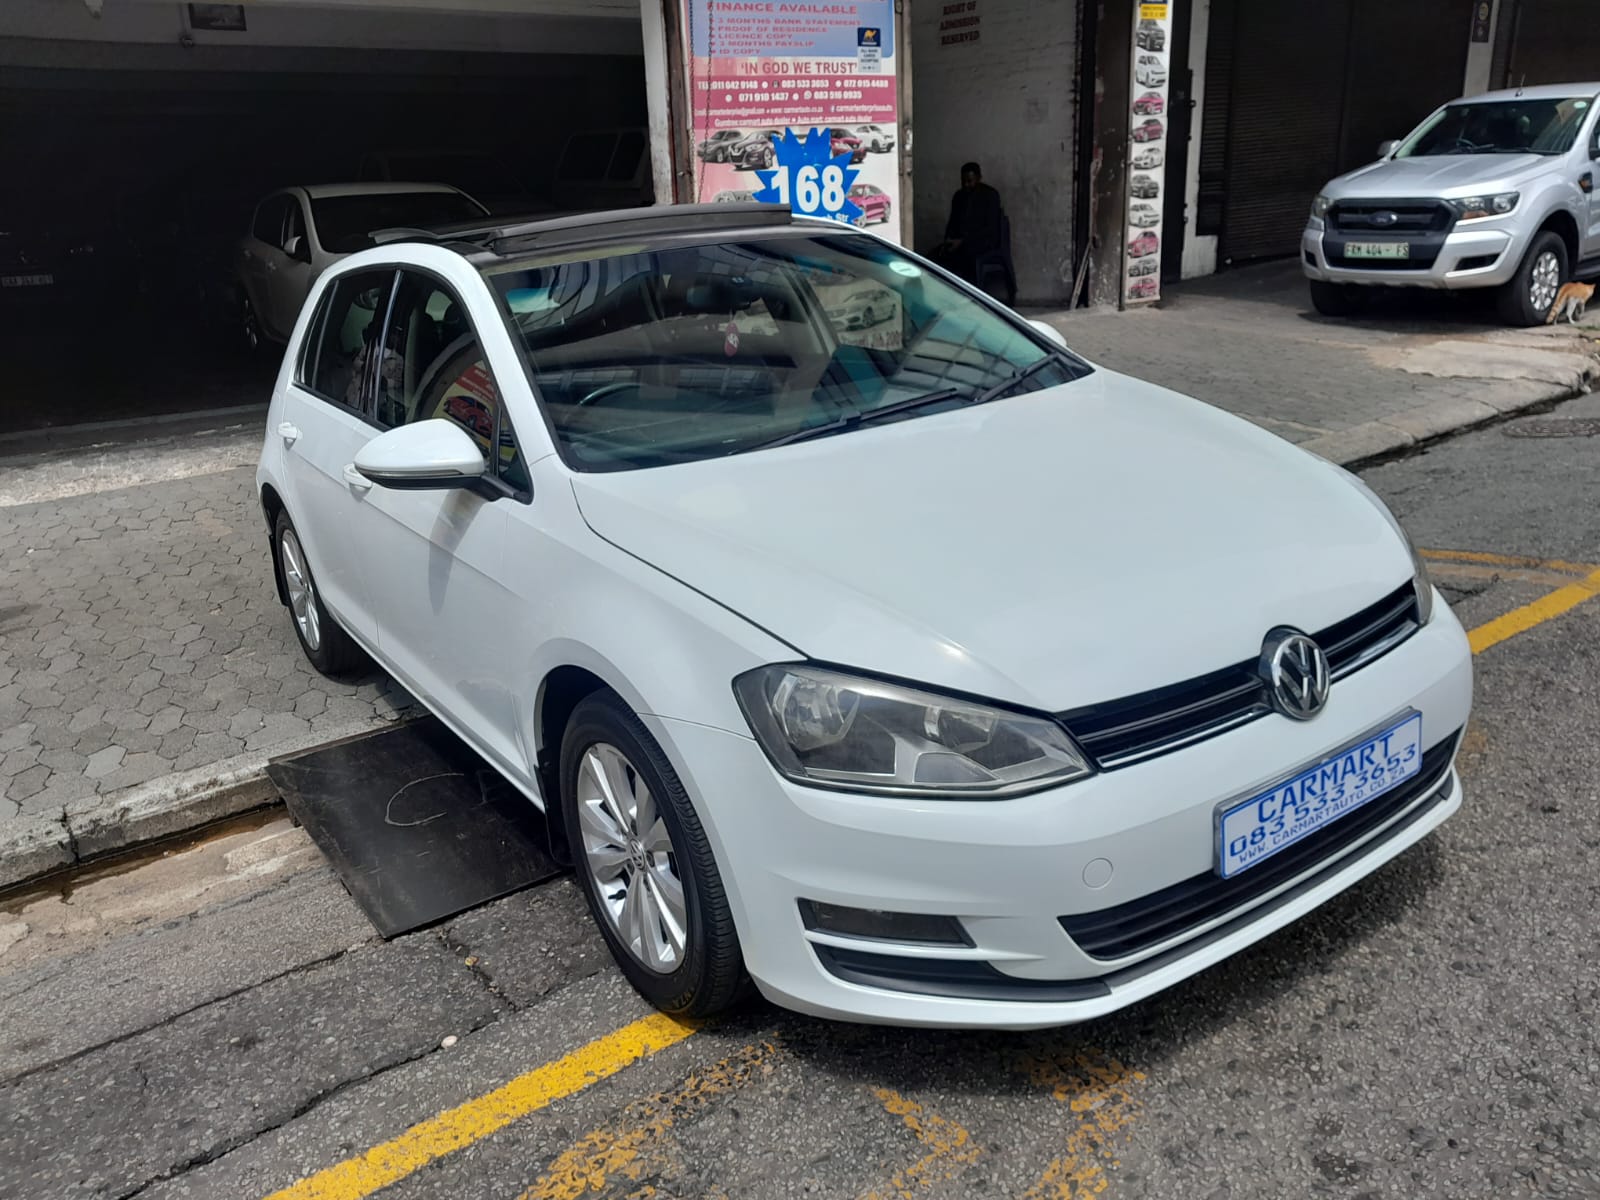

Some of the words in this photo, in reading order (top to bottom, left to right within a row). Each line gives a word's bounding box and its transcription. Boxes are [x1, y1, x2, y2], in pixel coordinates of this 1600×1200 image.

[706, 2, 777, 13] FINANCE
[779, 4, 858, 15] AVAILABLE
[941, 31, 980, 46] RESERVED
[762, 63, 789, 75] GOD
[791, 63, 812, 74] WE
[770, 164, 844, 213] 168
[1257, 733, 1394, 823] CARMART
[1230, 815, 1286, 857] 083
[1294, 783, 1346, 822] 533
[1354, 743, 1416, 790] 3653
